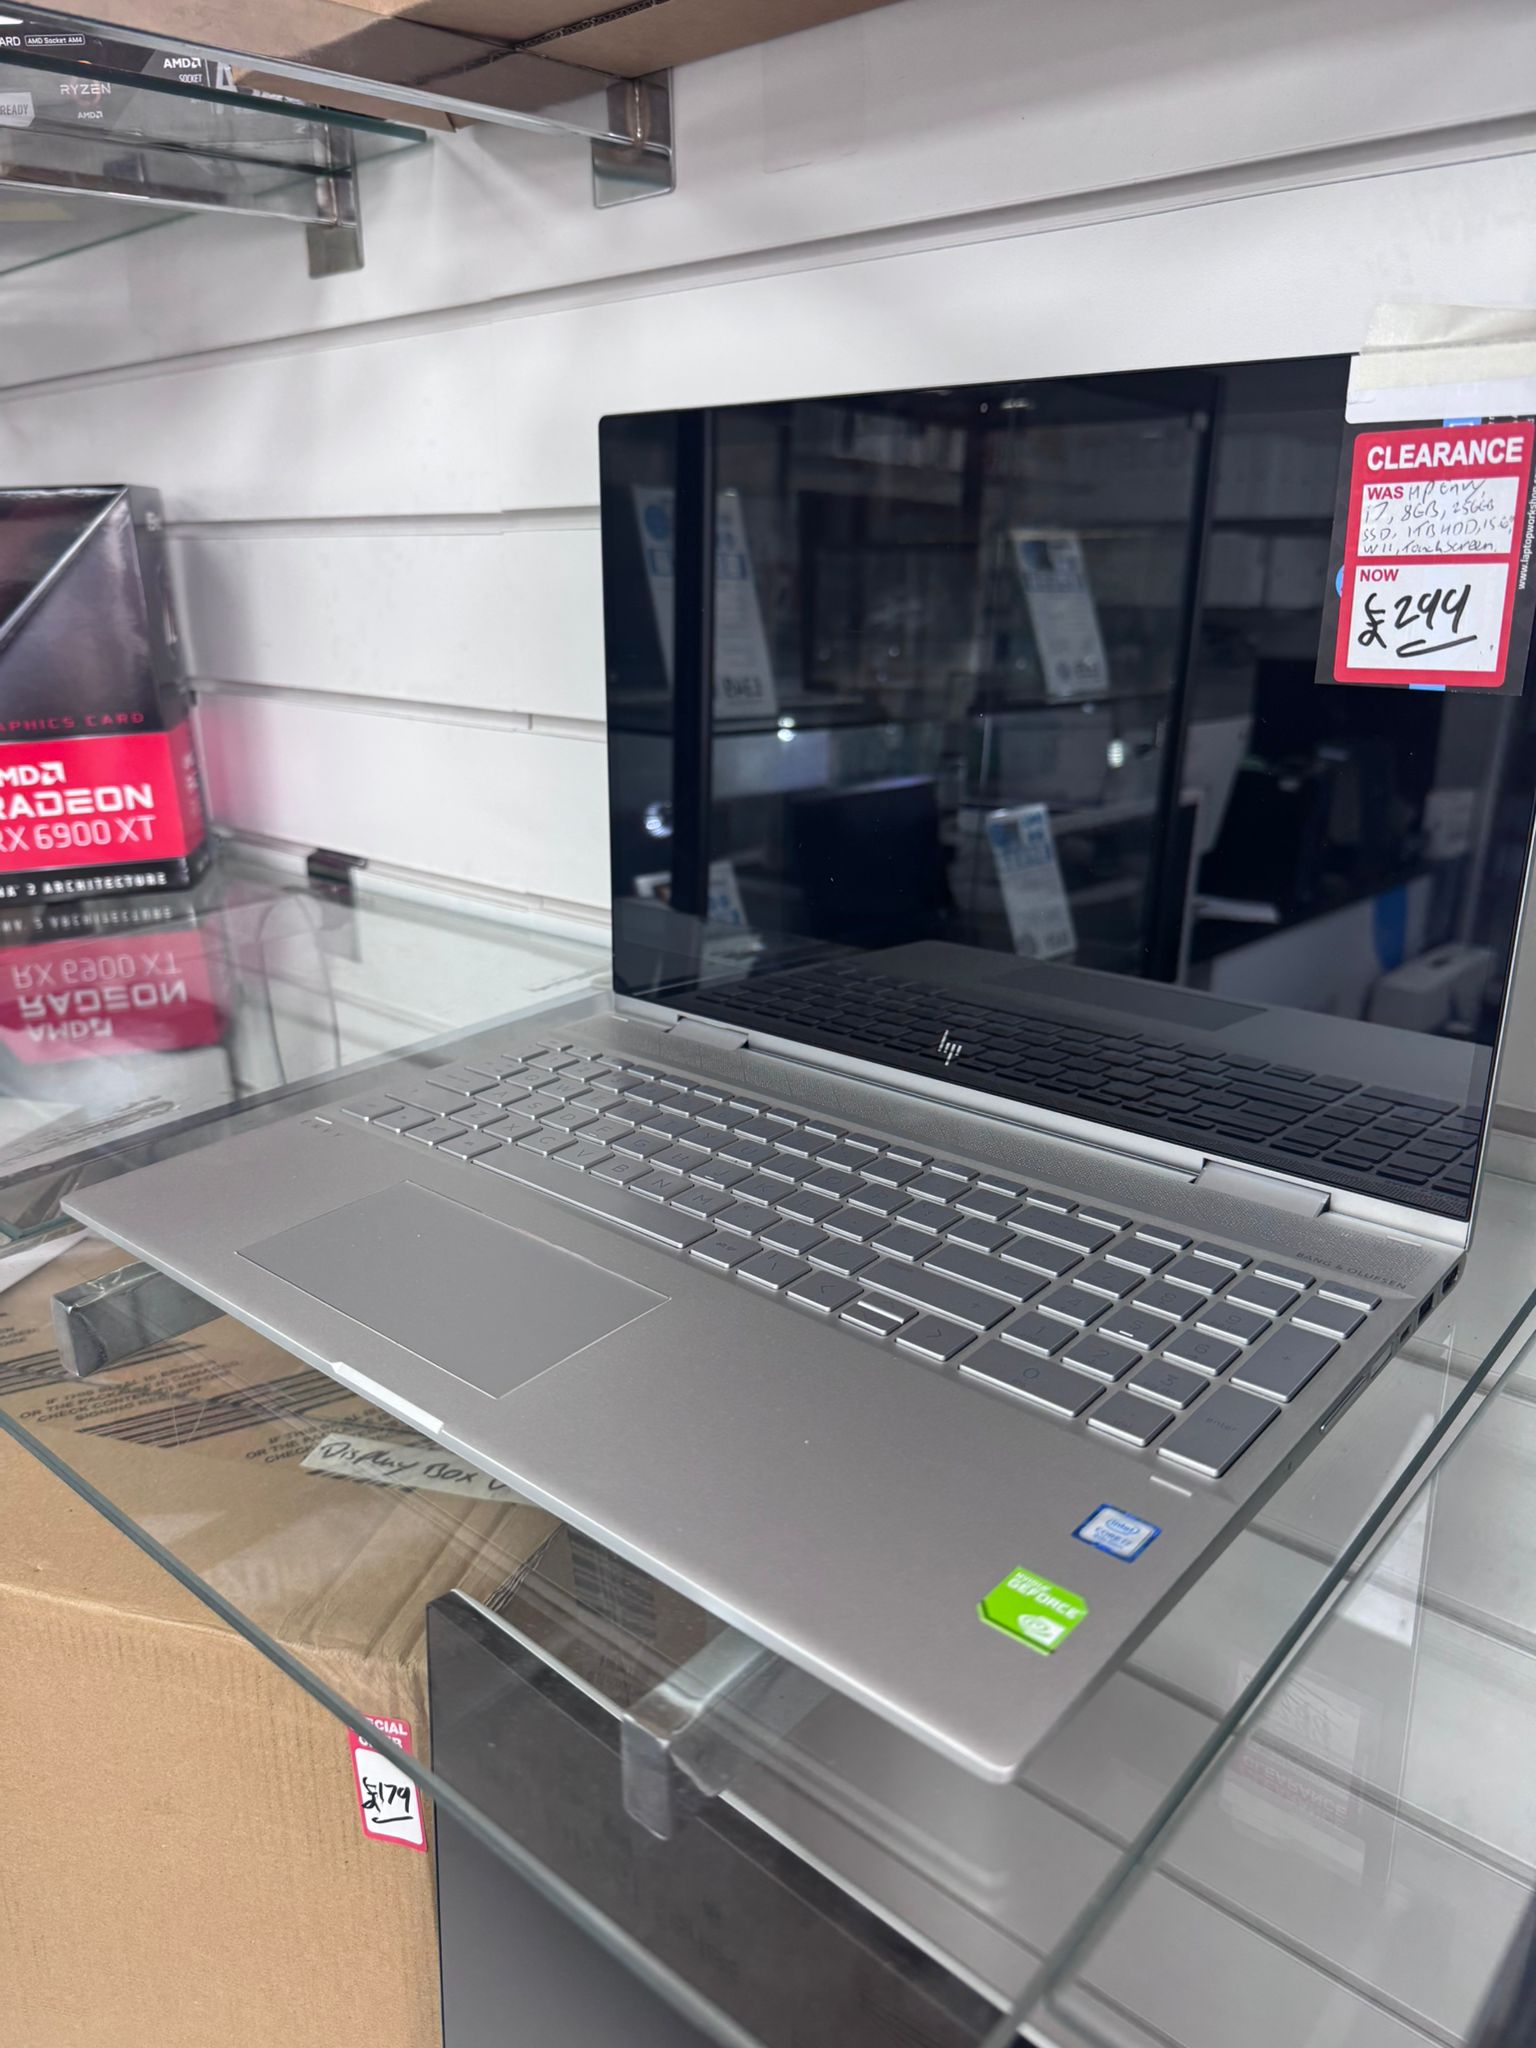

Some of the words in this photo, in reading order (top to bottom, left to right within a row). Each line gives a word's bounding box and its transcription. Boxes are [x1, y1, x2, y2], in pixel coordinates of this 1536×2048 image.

[163, 57, 191, 69] AMD
[60, 83, 111, 95] RYZEN
[179, 74, 203, 83] SOCKET
[1367, 436, 1525, 471] CLEARANCE
[1367, 486, 1404, 500] WAS
[1360, 569, 1399, 582] NOW
[1357, 584, 1471, 649] £299
[85, 711, 145, 728] CARD
[33, 819, 111, 850] 6900
[115, 814, 156, 844] XT
[26, 883, 37, 896] 2
[42, 872, 167, 895] ARCHITECTURE
[1295, 1251, 1333, 1267] BANG
[1335, 1263, 1344, 1271] &
[1347, 1266, 1407, 1290] OLUFSEN
[1006, 1579, 1079, 1620] GEFORCE
[361, 1776, 412, 1814] £179
